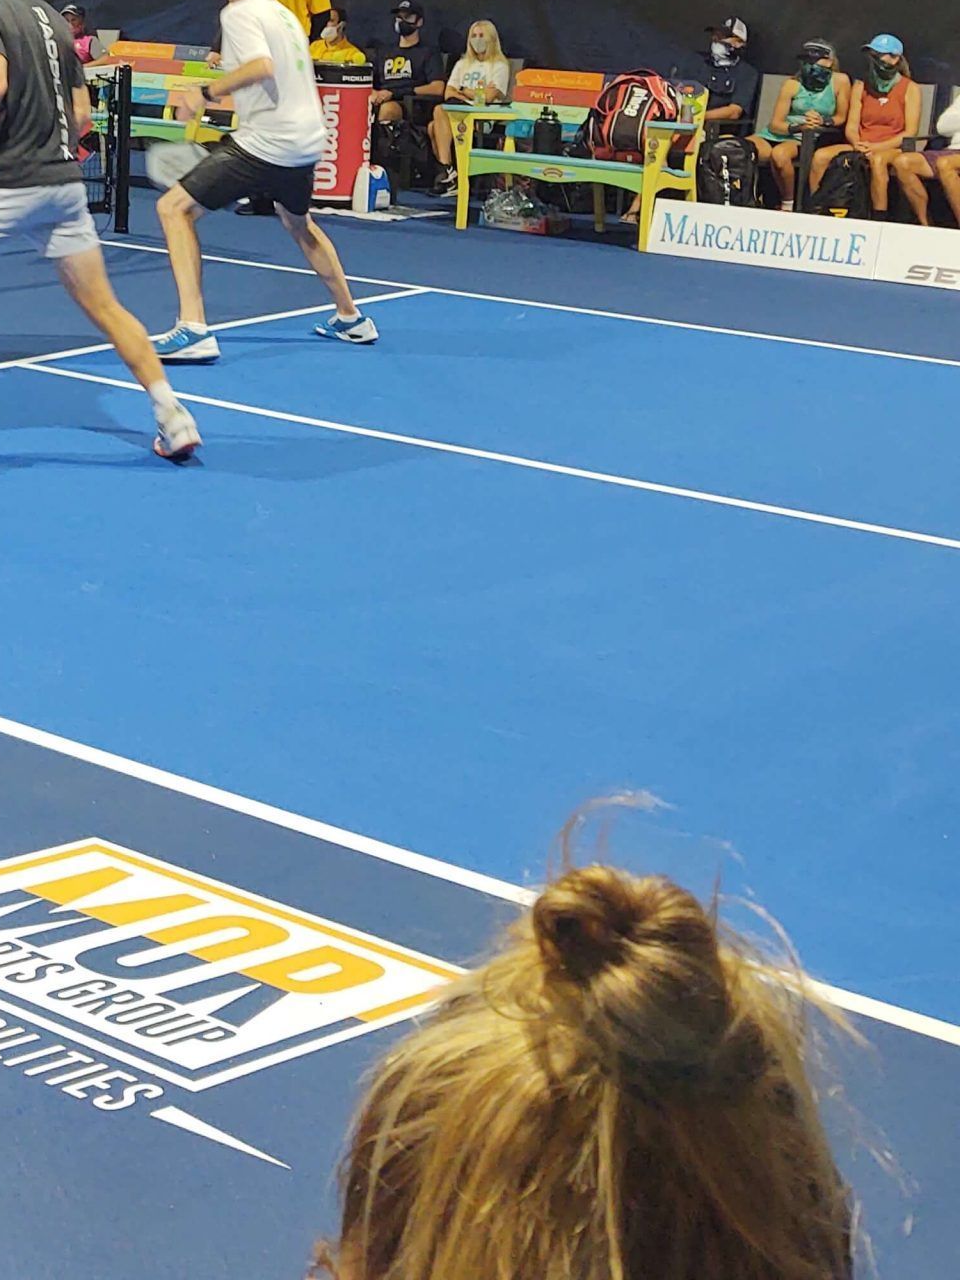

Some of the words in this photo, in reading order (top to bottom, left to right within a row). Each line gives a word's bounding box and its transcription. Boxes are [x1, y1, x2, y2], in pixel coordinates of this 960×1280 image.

[31, 6, 74, 161] PADDLETEK
[383, 56, 412, 75] PPA
[660, 212, 867, 266] MARGARITAVILLE
[53, 979, 238, 1048] GROUP
